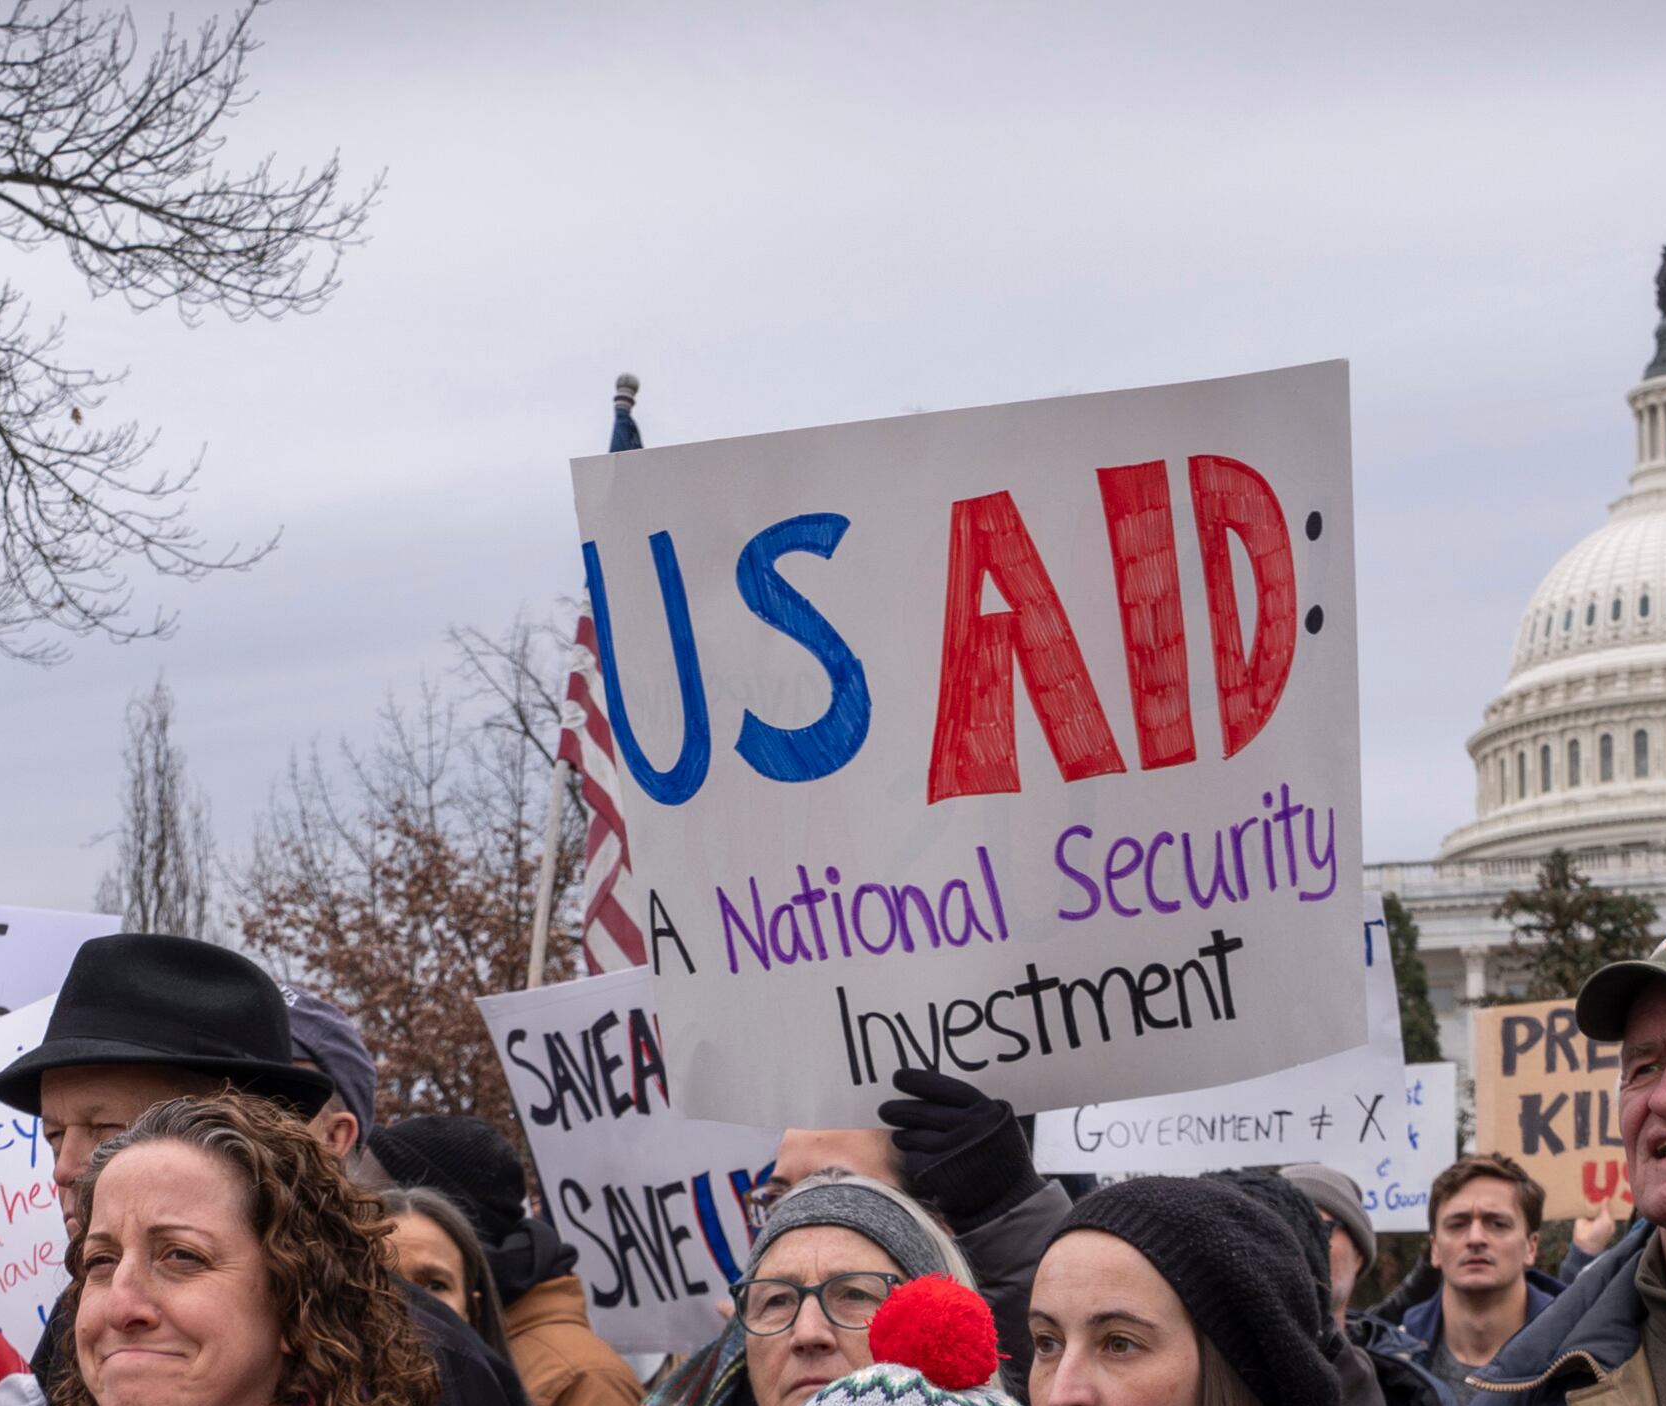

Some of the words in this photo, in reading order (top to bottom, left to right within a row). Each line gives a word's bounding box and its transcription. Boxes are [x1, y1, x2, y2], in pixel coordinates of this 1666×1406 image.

[582, 512, 871, 805] US
[927, 454, 1324, 805] AID:
[650, 888, 697, 976] A
[716, 846, 1009, 974] National
[1055, 783, 1336, 922] Security
[507, 1010, 634, 1130] SAVE
[837, 929, 1242, 1086] Investment
[1355, 1094, 1387, 1143] X
[560, 1178, 709, 1309] SAVE
[691, 1158, 778, 1287] U
